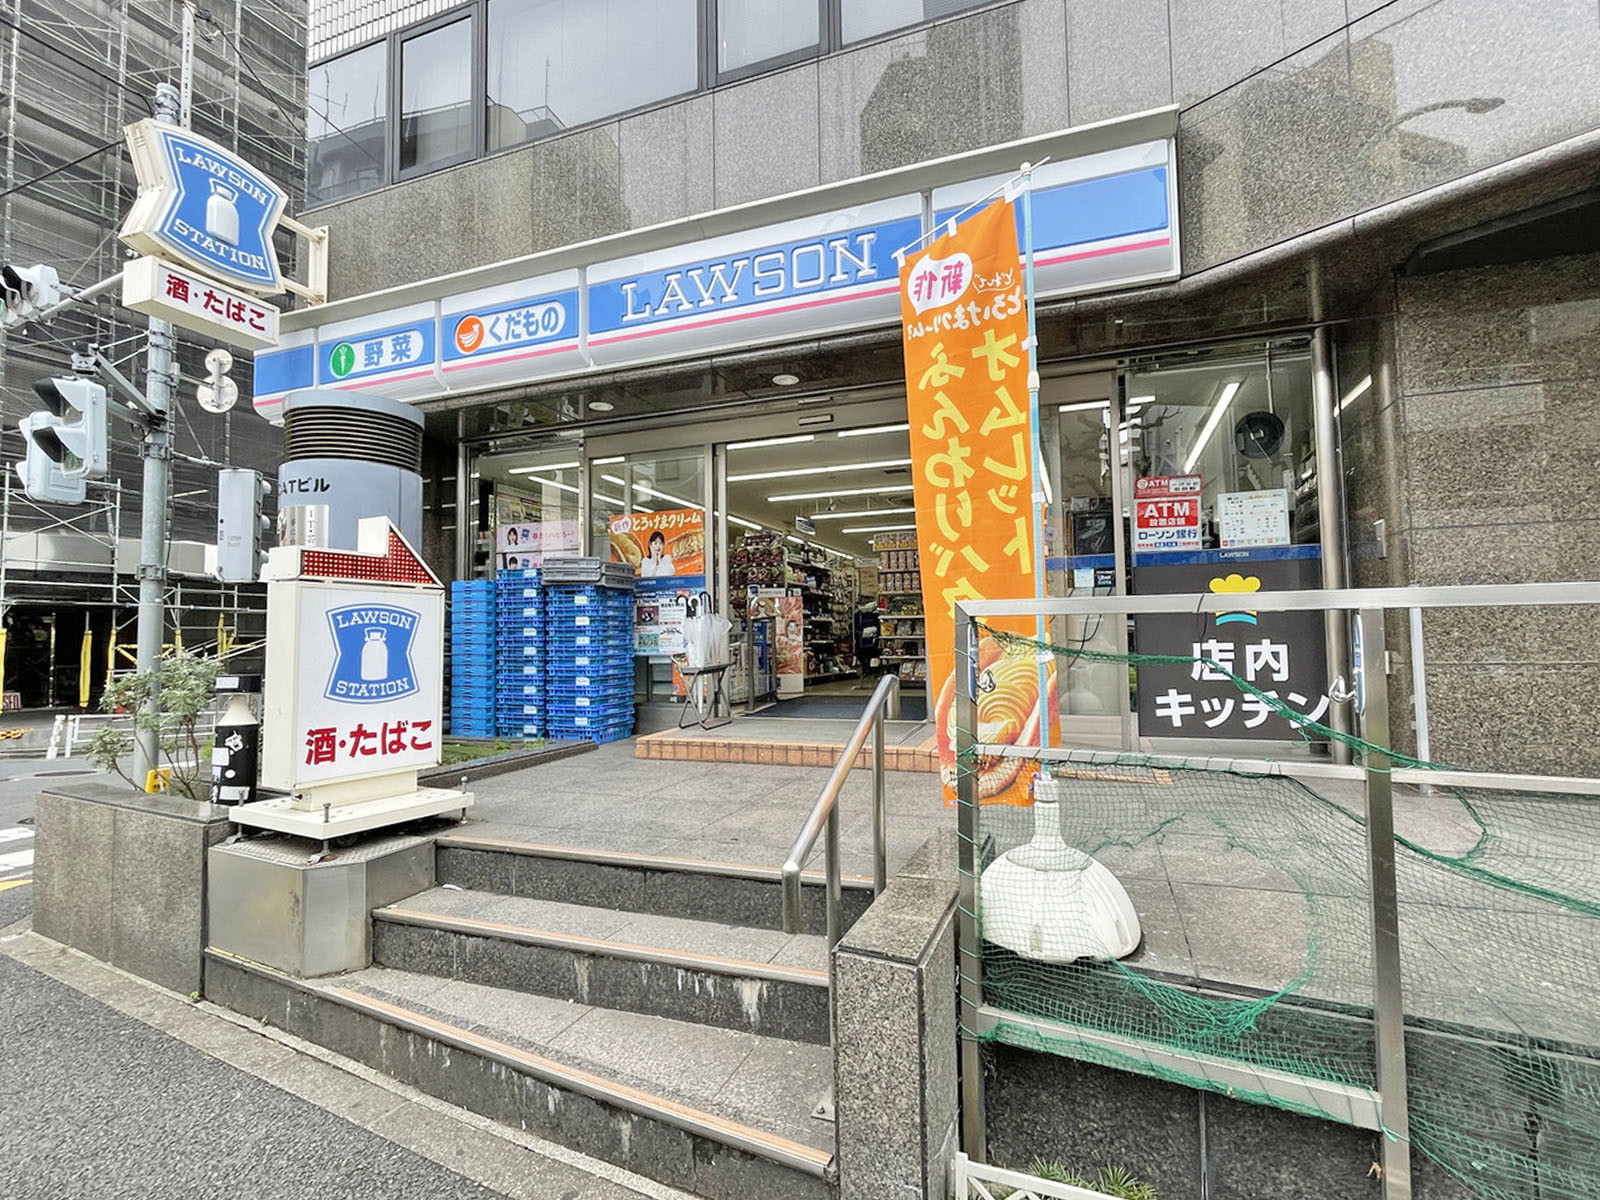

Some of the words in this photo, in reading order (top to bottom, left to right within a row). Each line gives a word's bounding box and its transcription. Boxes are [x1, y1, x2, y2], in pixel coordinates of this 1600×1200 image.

[175, 147, 269, 206] LAWSON
[172, 218, 266, 271] STATION
[620, 231, 877, 323] LAWSON
[166, 274, 267, 332] 酒・たばこ
[488, 307, 562, 342] くだもの
[364, 335, 412, 367] 野菜
[276, 476, 330, 494] ATビル
[1148, 479, 1168, 487] ATM
[1143, 501, 1190, 518] ATM
[1138, 529, 1197, 540] ローソン銀行
[337, 611, 413, 630] LAWSON
[1191, 638, 1290, 682] 店内
[335, 676, 410, 697] STATION
[1155, 688, 1330, 729] キッチン
[305, 719, 433, 766] 酒・たばこ
